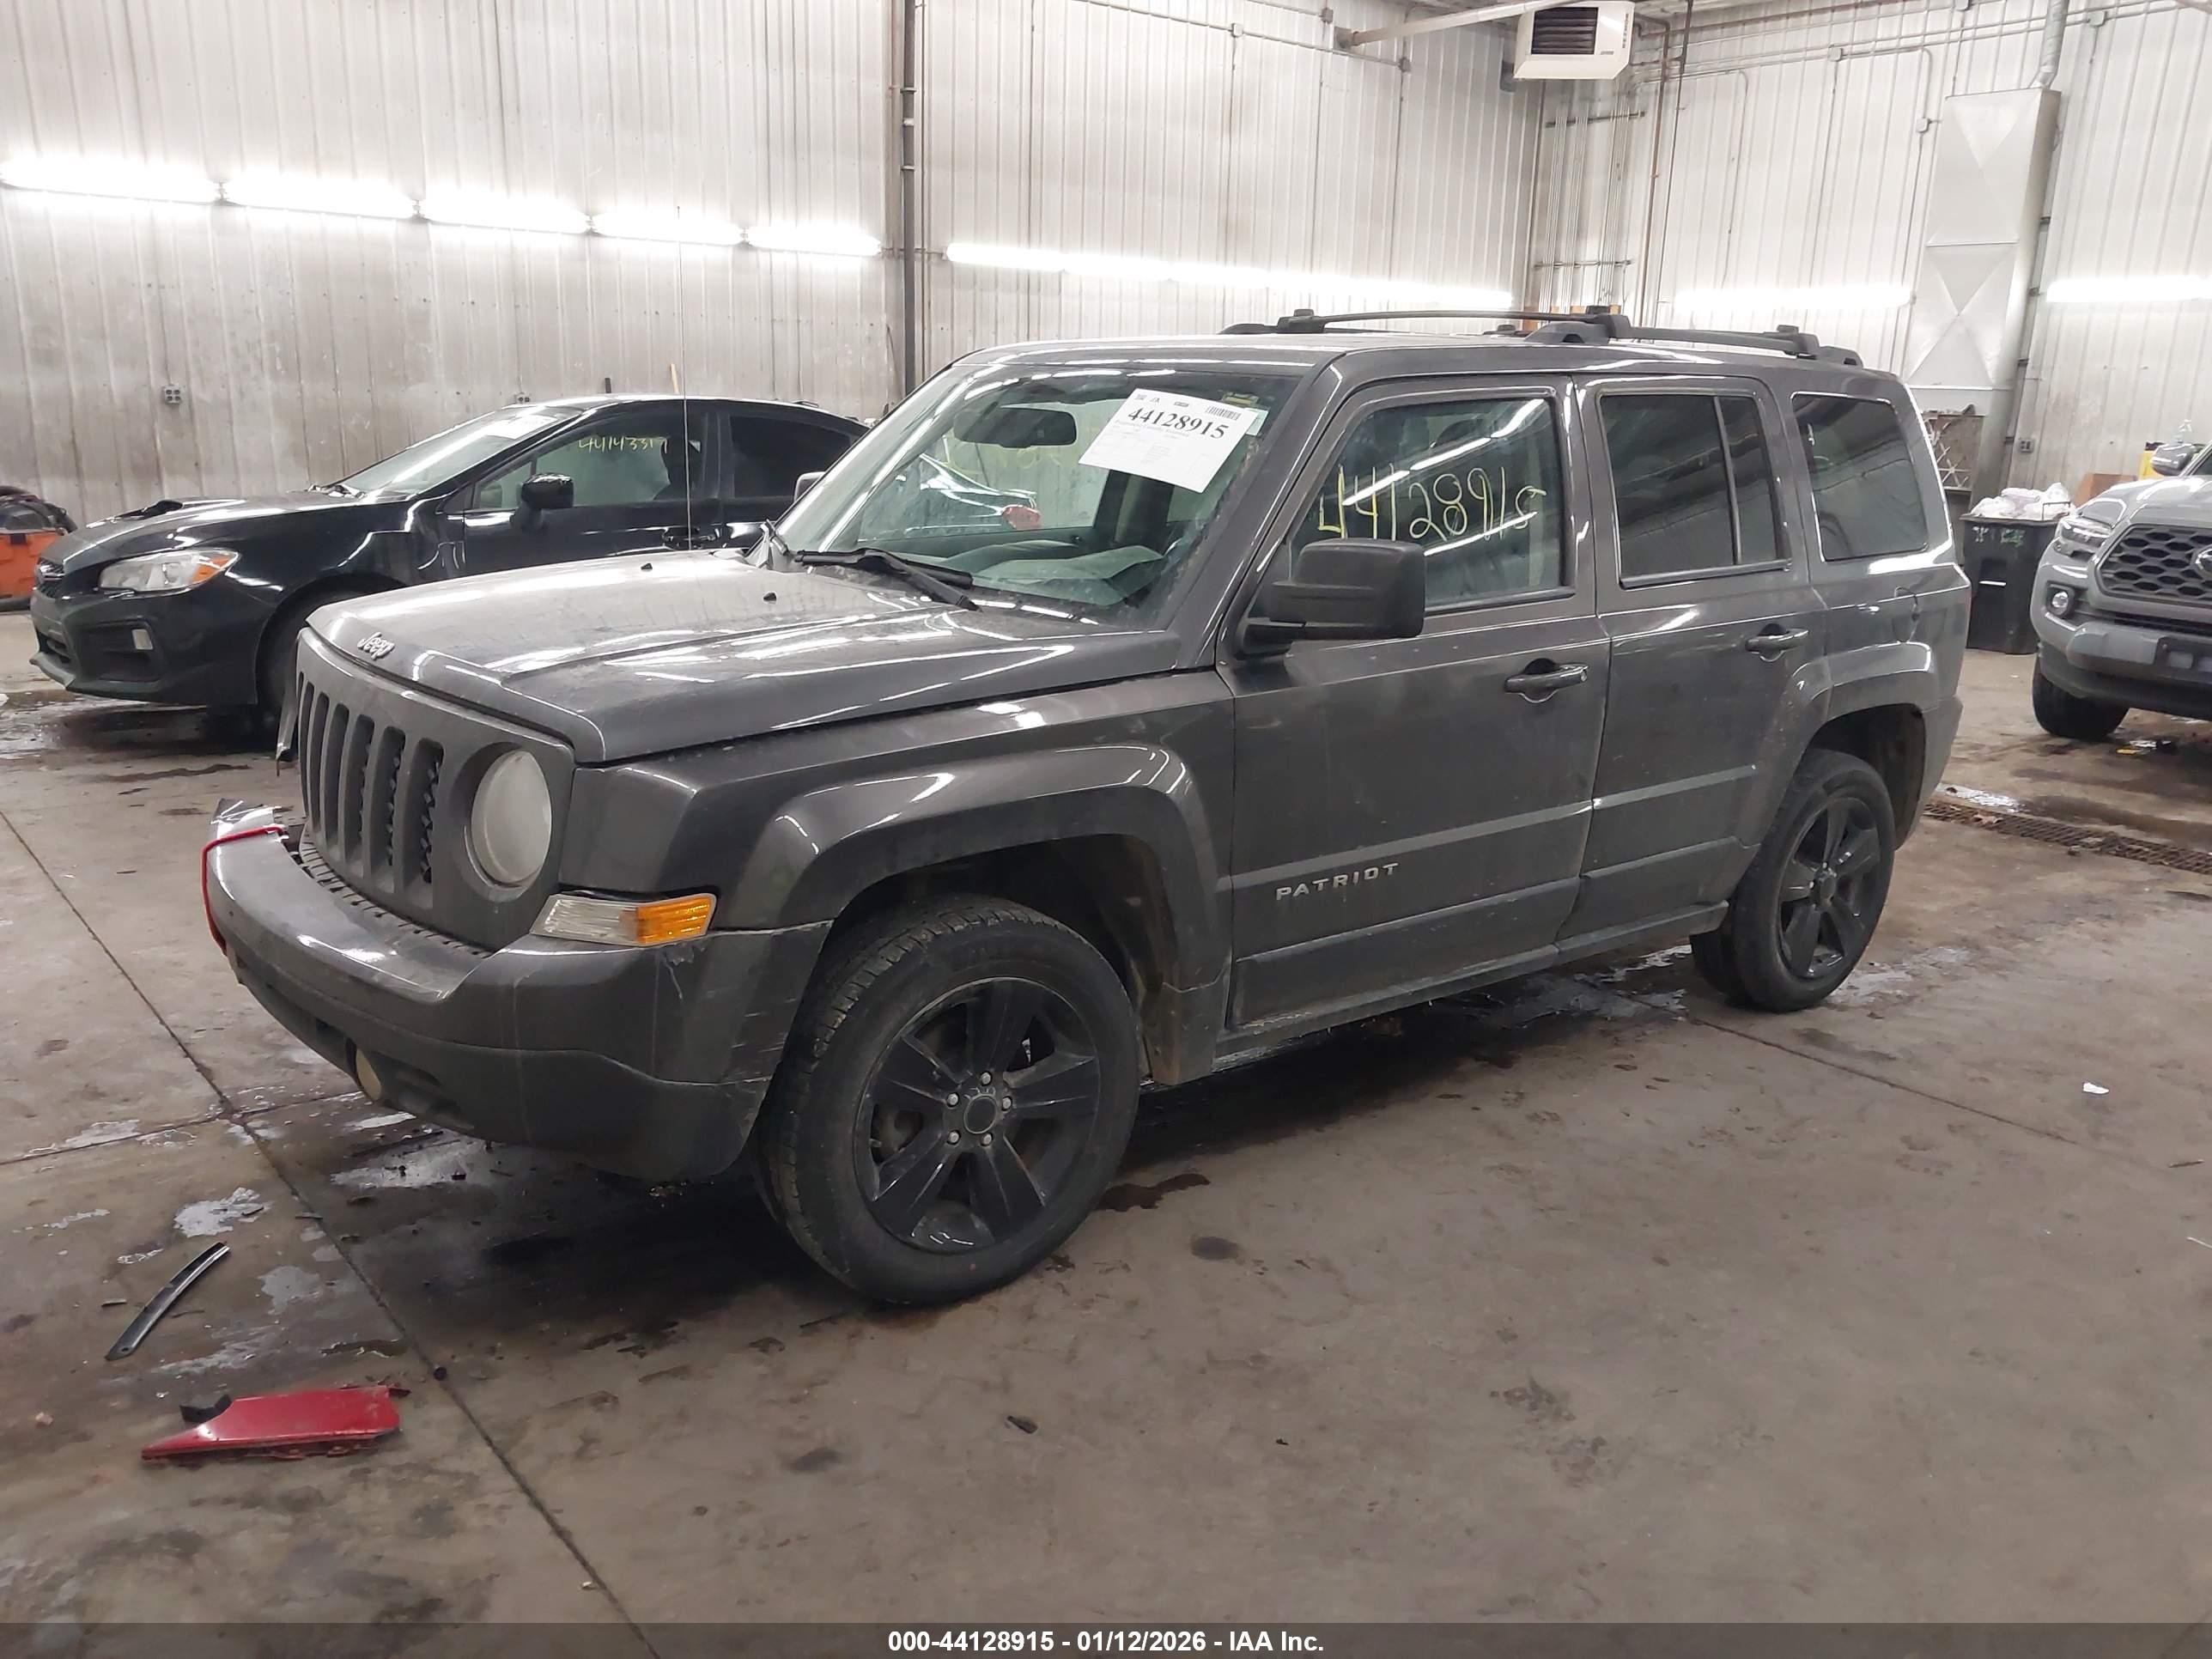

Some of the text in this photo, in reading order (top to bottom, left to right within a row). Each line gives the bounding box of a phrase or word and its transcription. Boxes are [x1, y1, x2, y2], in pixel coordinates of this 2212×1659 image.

[1127, 406, 1230, 439] 44128915
[1318, 462, 1547, 542] 44128915
[357, 632, 395, 660] Jeep
[1276, 862, 1399, 900] PATRIOT
